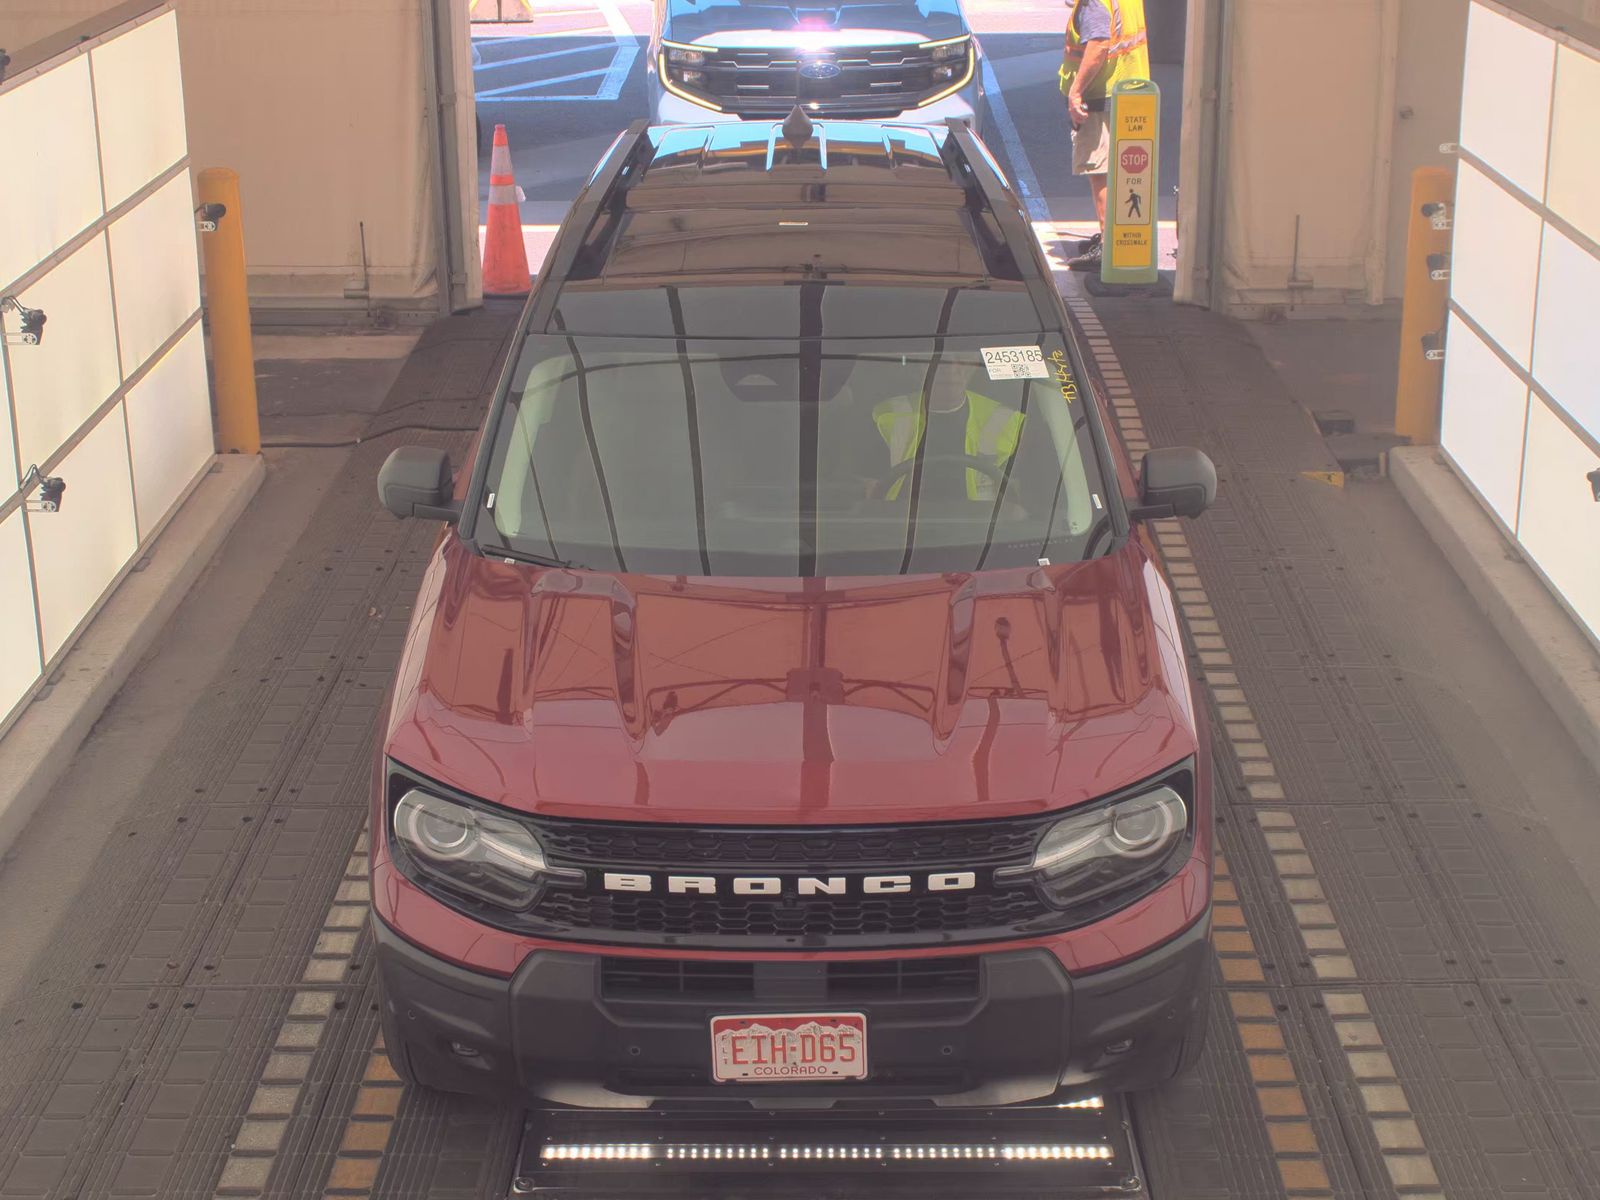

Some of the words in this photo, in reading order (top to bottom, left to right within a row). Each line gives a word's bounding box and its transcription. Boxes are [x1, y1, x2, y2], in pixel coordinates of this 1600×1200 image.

[1122, 154, 1147, 166] STOP
[1126, 177, 1142, 185] FOR
[985, 349, 1043, 364] 2453185
[604, 872, 976, 894] BRONCO
[754, 1065, 827, 1076] COLORADO
